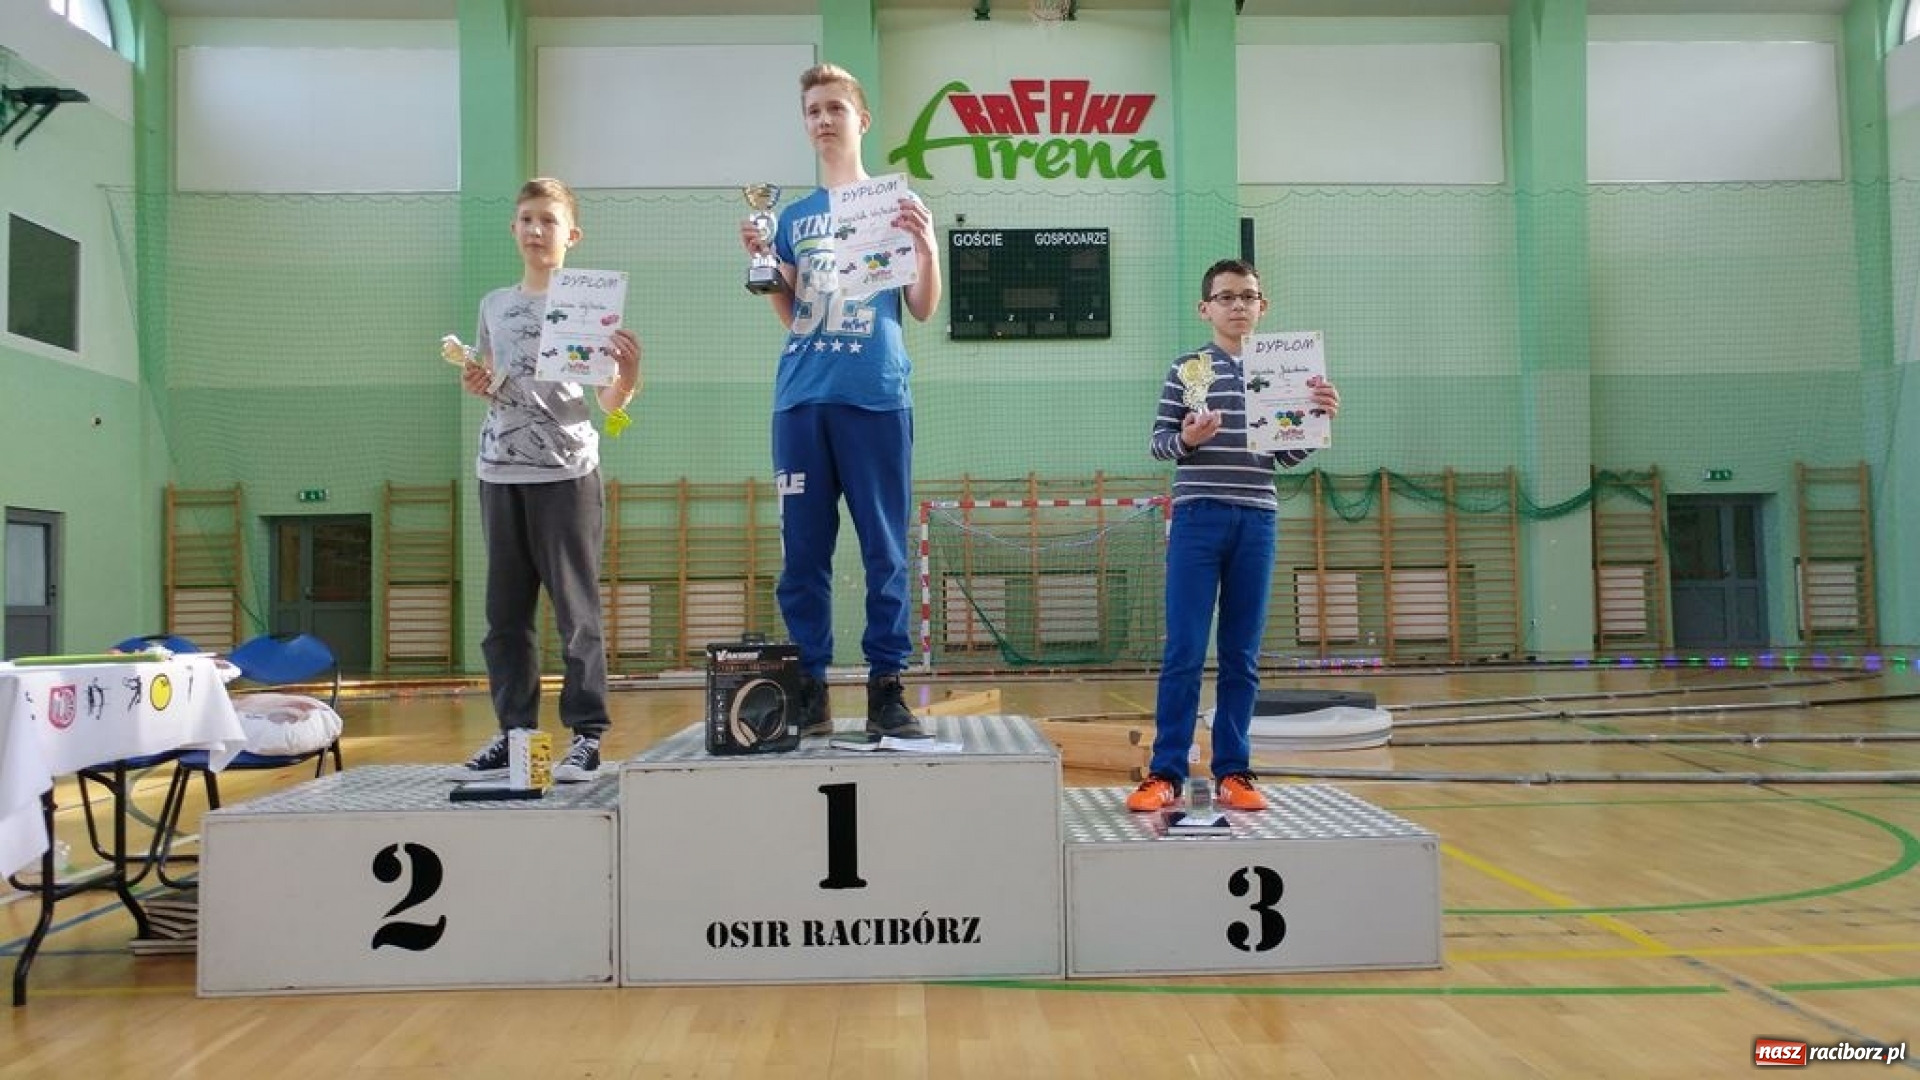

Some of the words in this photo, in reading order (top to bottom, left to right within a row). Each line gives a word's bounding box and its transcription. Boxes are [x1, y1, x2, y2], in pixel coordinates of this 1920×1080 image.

[888, 80, 1166, 180] Arena
[948, 80, 1156, 134] RAFAKO
[842, 180, 898, 203] DYPLOM
[953, 231, 1004, 247] GOŚCIE
[1034, 231, 1108, 246] GOSPODARZE
[561, 274, 618, 290] DYPLOM
[1255, 338, 1316, 354] DYPLOM
[817, 781, 868, 890] 1
[371, 842, 447, 952] 2
[1226, 865, 1287, 952] 3
[706, 919, 792, 949] OSIR
[801, 909, 982, 949] RACIBÓRZ
